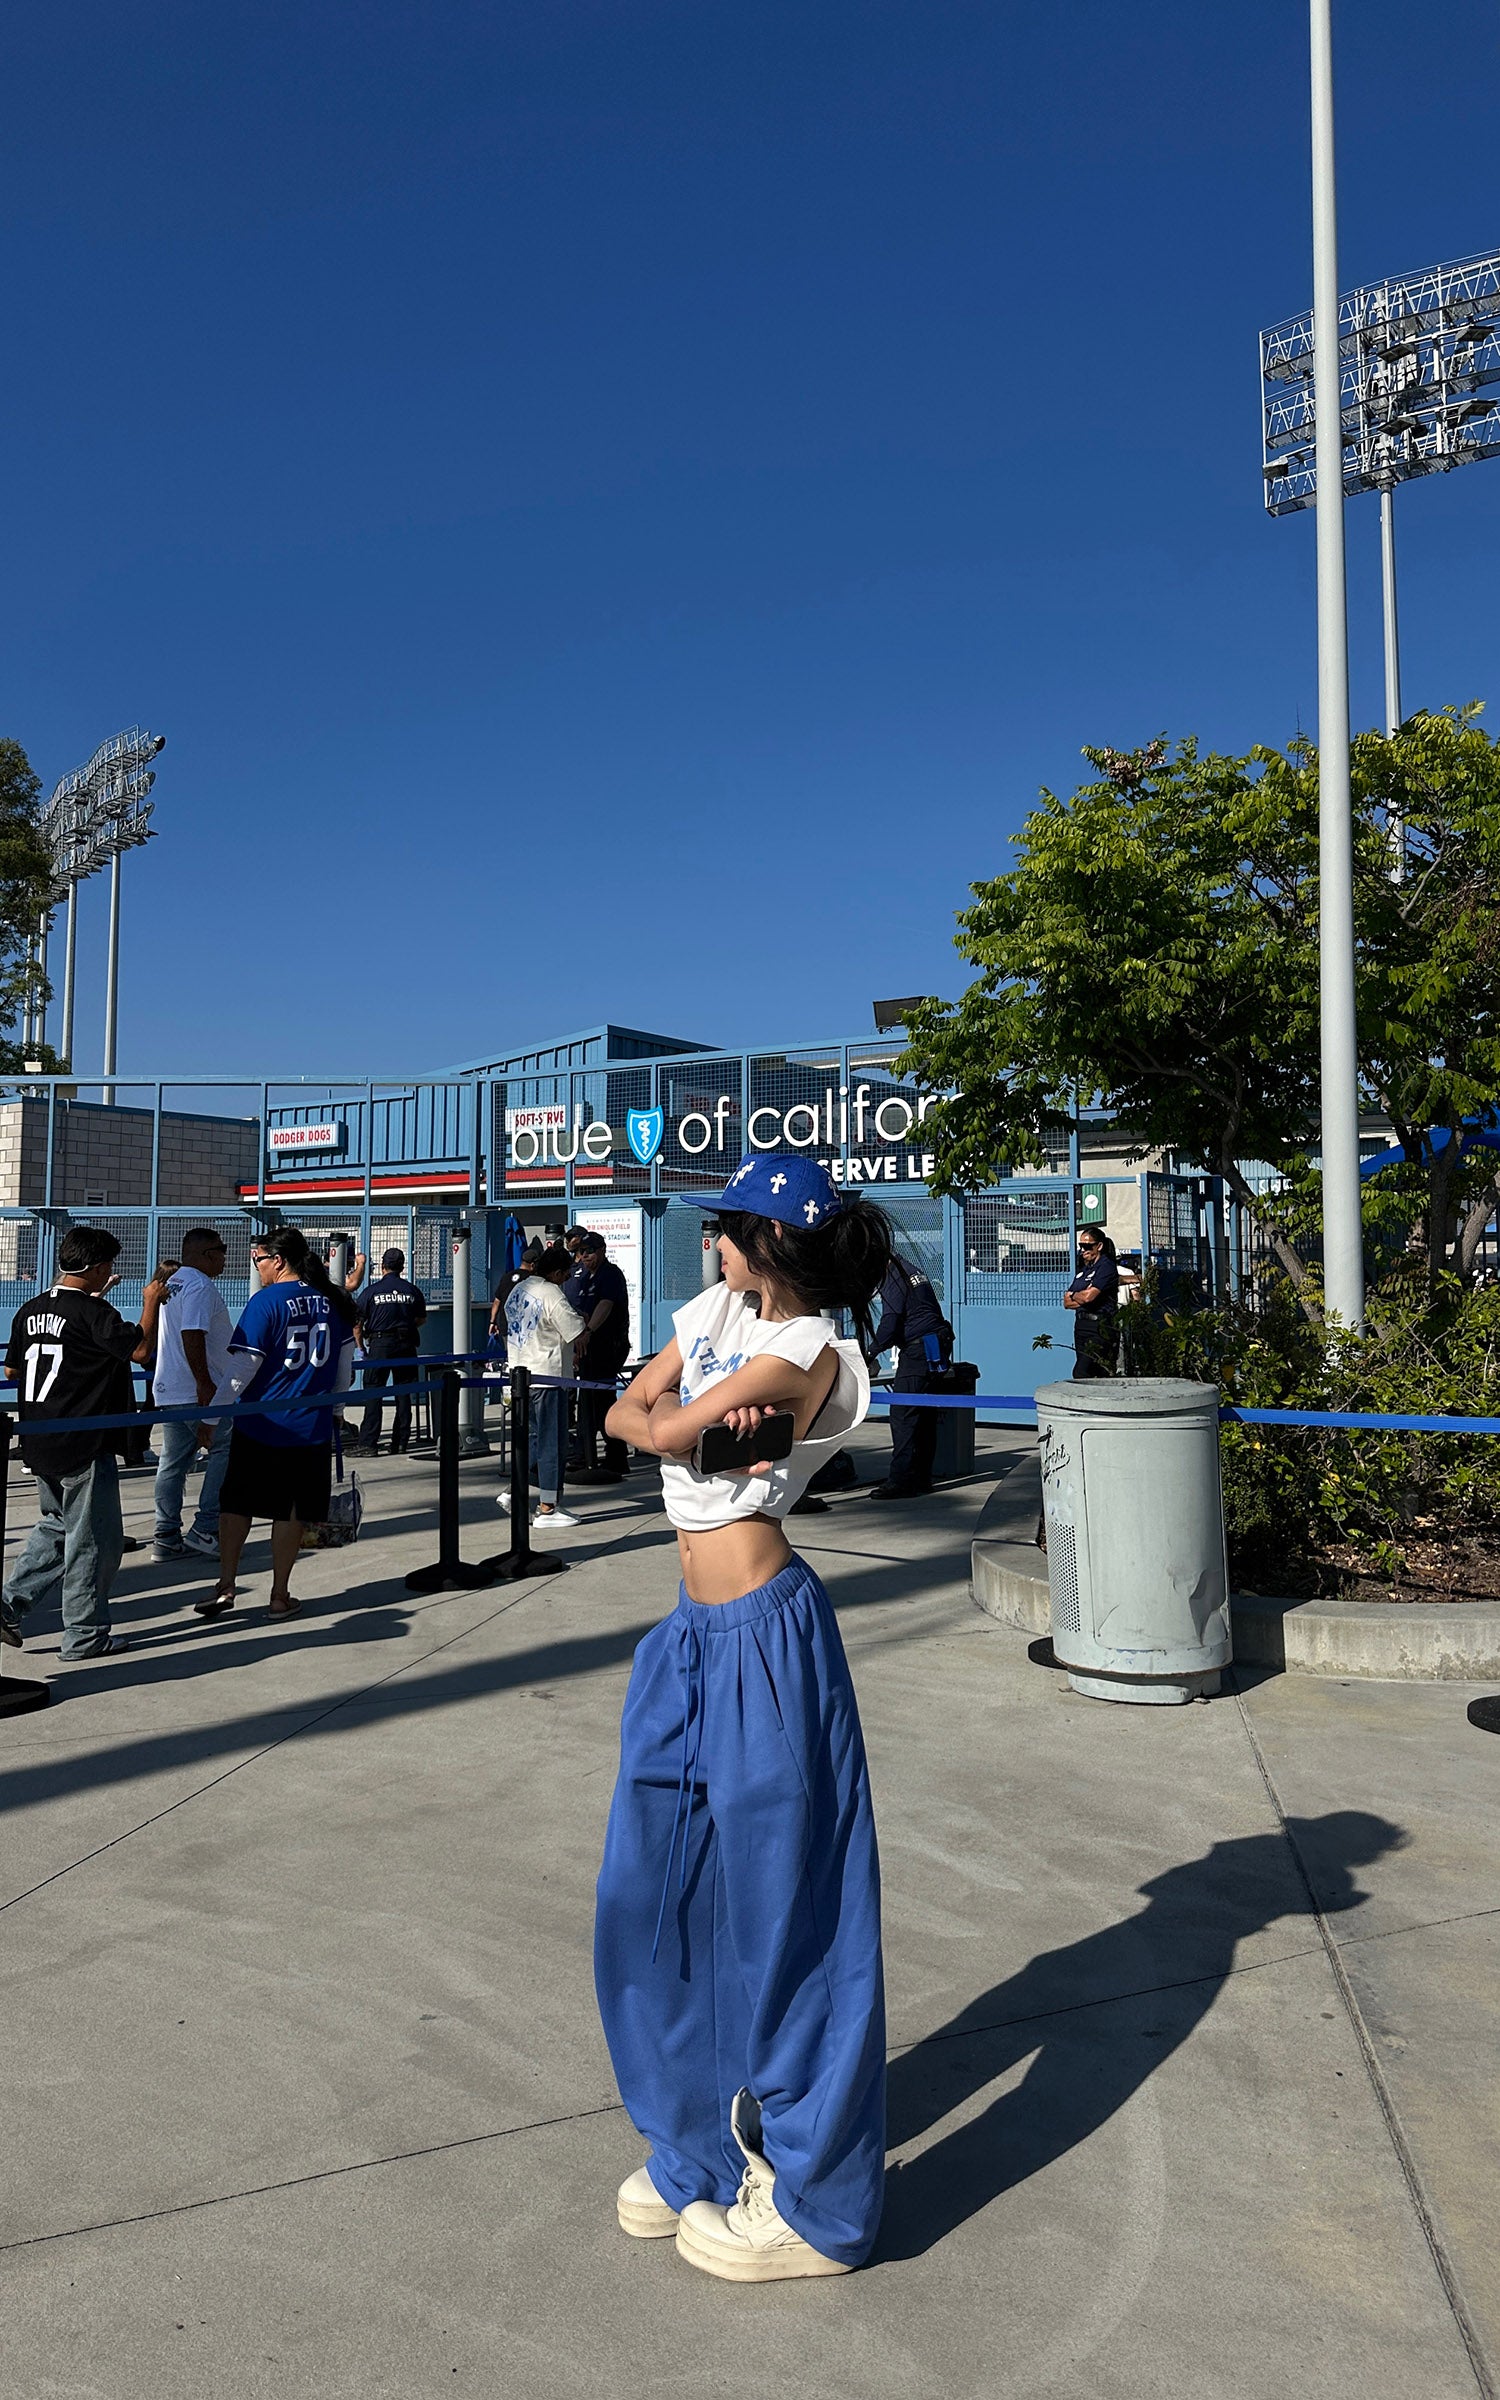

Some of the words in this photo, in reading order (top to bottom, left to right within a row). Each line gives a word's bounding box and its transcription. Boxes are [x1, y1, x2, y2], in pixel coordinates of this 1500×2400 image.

[515, 1110, 564, 1127] SOFT-SRVE
[273, 1131, 305, 1145] DODGER
[308, 1129, 331, 1142] DOGS
[512, 1114, 613, 1165] blue
[678, 1096, 730, 1153] of
[607, 1233, 631, 1241] STADIUM
[703, 1238, 711, 1250] 8
[453, 1244, 460, 1255] 9
[286, 1295, 330, 1318] BETTS
[373, 1294, 415, 1305] SECURITY
[283, 1322, 331, 1370] 50
[24, 1342, 63, 1402] 17
